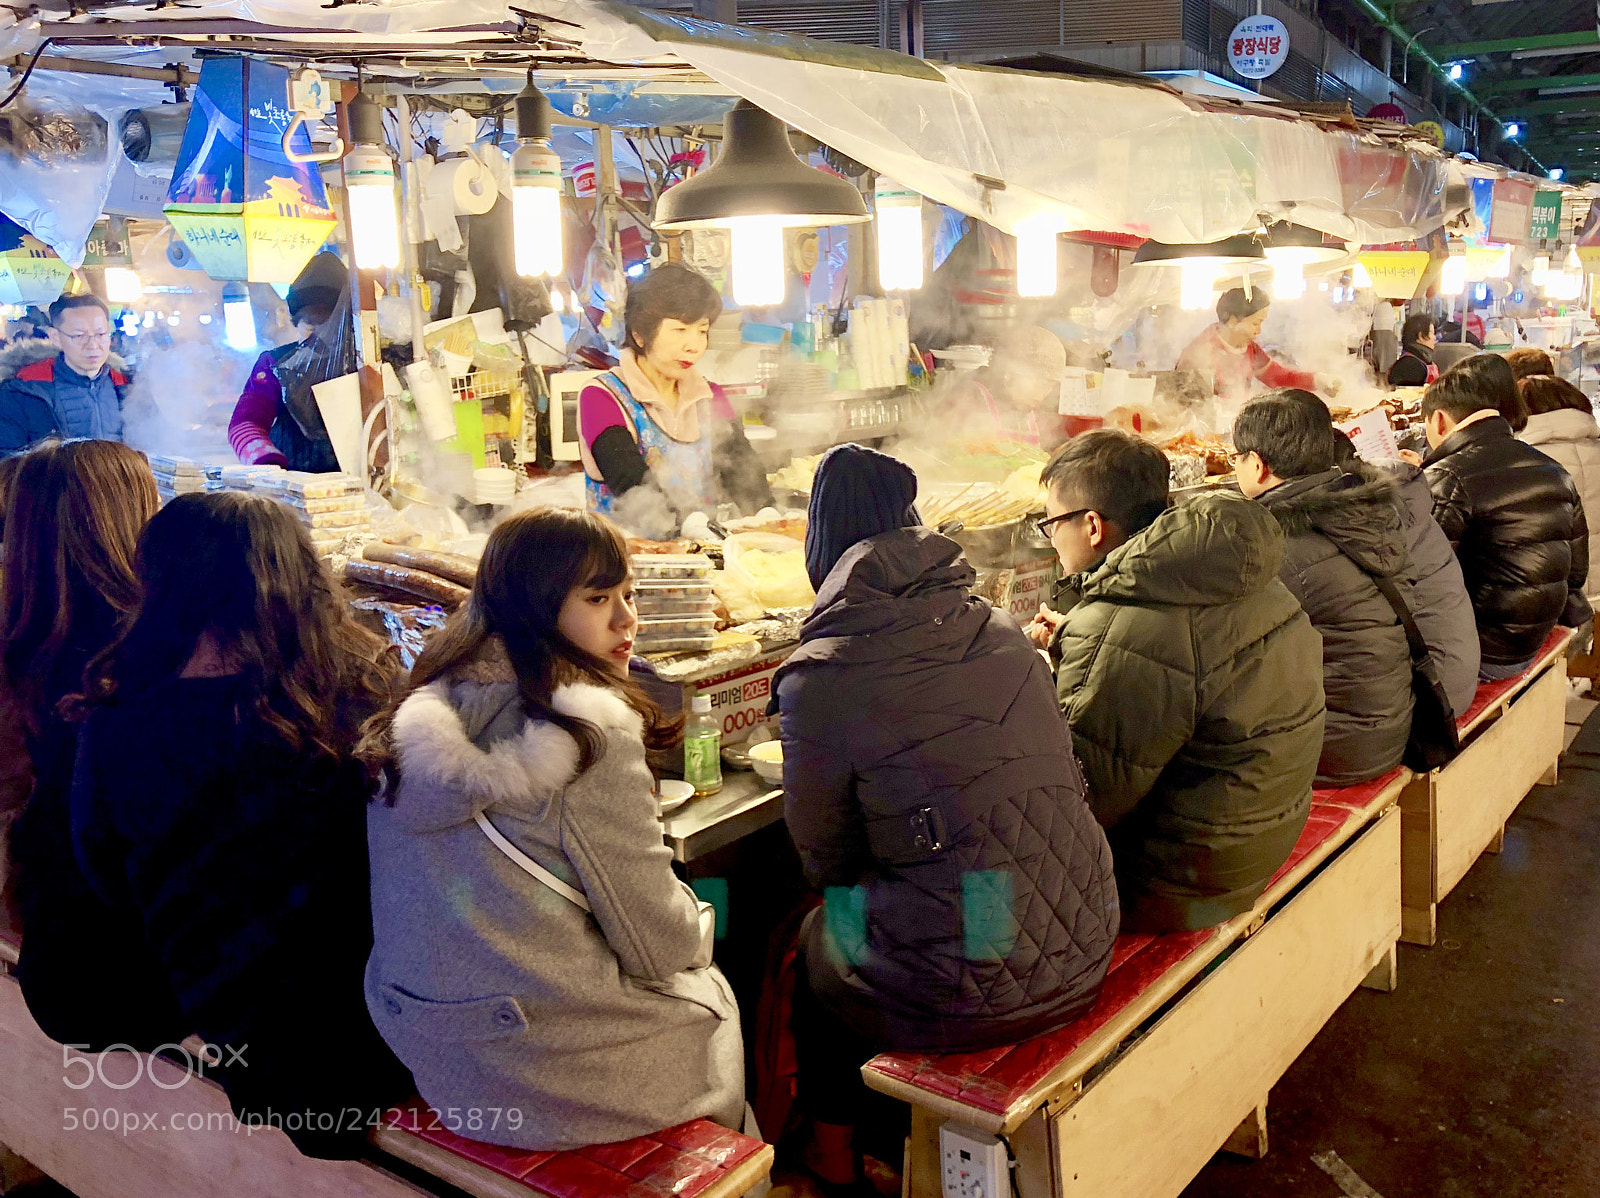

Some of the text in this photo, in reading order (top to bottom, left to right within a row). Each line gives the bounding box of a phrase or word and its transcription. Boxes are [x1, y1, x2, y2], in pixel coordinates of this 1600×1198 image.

[1233, 35, 1281, 56] 광장식당
[1532, 206, 1556, 224] 떡볶이
[1530, 226, 1548, 238] 723
[744, 679, 768, 701] 20도
